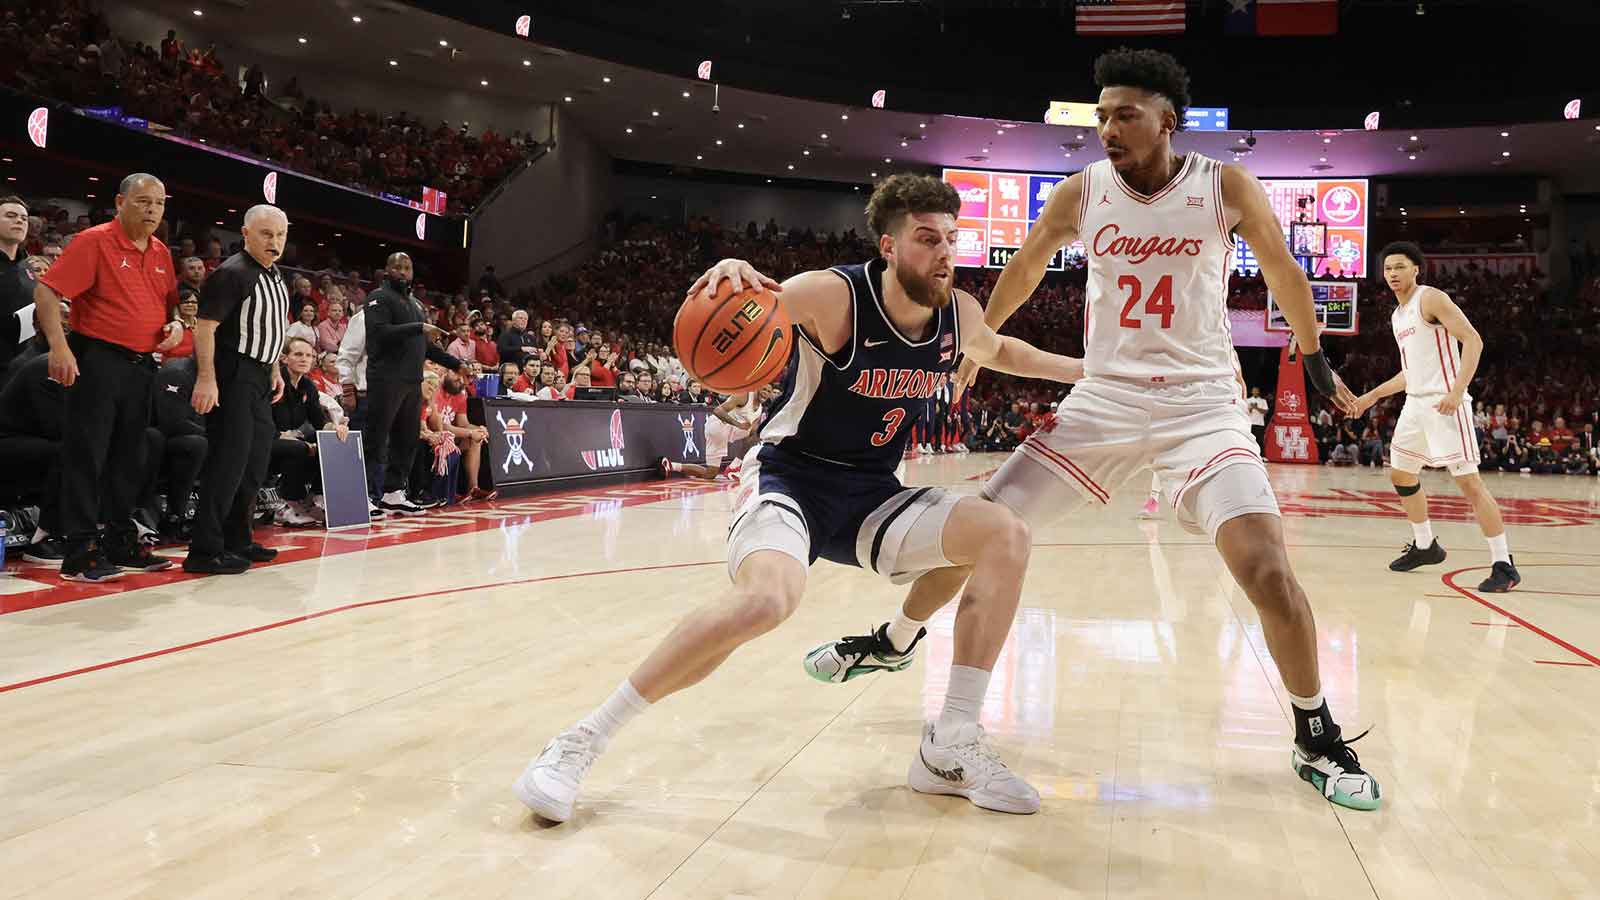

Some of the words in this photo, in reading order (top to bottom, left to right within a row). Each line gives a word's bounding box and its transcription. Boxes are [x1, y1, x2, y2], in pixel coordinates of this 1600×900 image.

[1000, 205, 1018, 218] 11
[1093, 224, 1203, 264] Cougars
[1117, 274, 1175, 329] 24
[711, 298, 765, 355] ELITE
[871, 408, 906, 447] 3
[1274, 425, 1309, 459] UH
